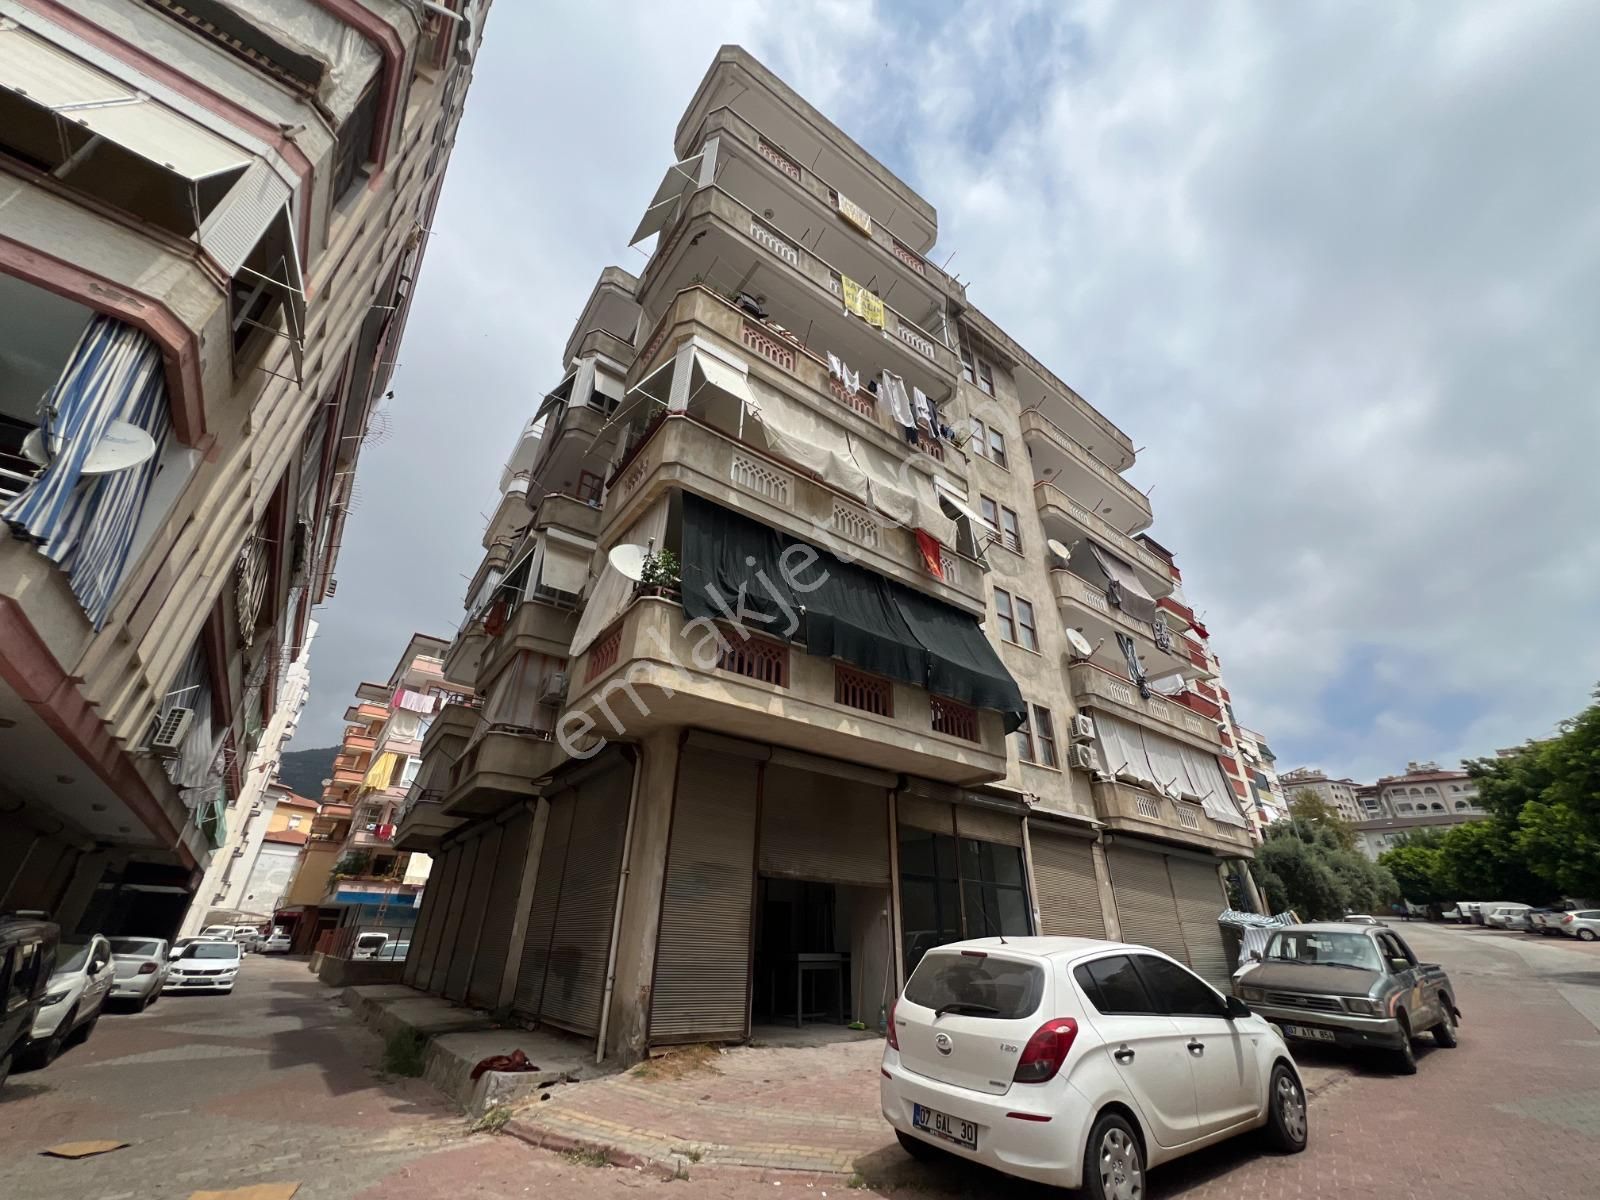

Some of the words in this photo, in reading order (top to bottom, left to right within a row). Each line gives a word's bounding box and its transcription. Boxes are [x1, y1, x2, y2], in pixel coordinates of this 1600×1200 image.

[920, 1108, 931, 1126] 07
[935, 1113, 953, 1134] GAL
[960, 1122, 974, 1141] 30
